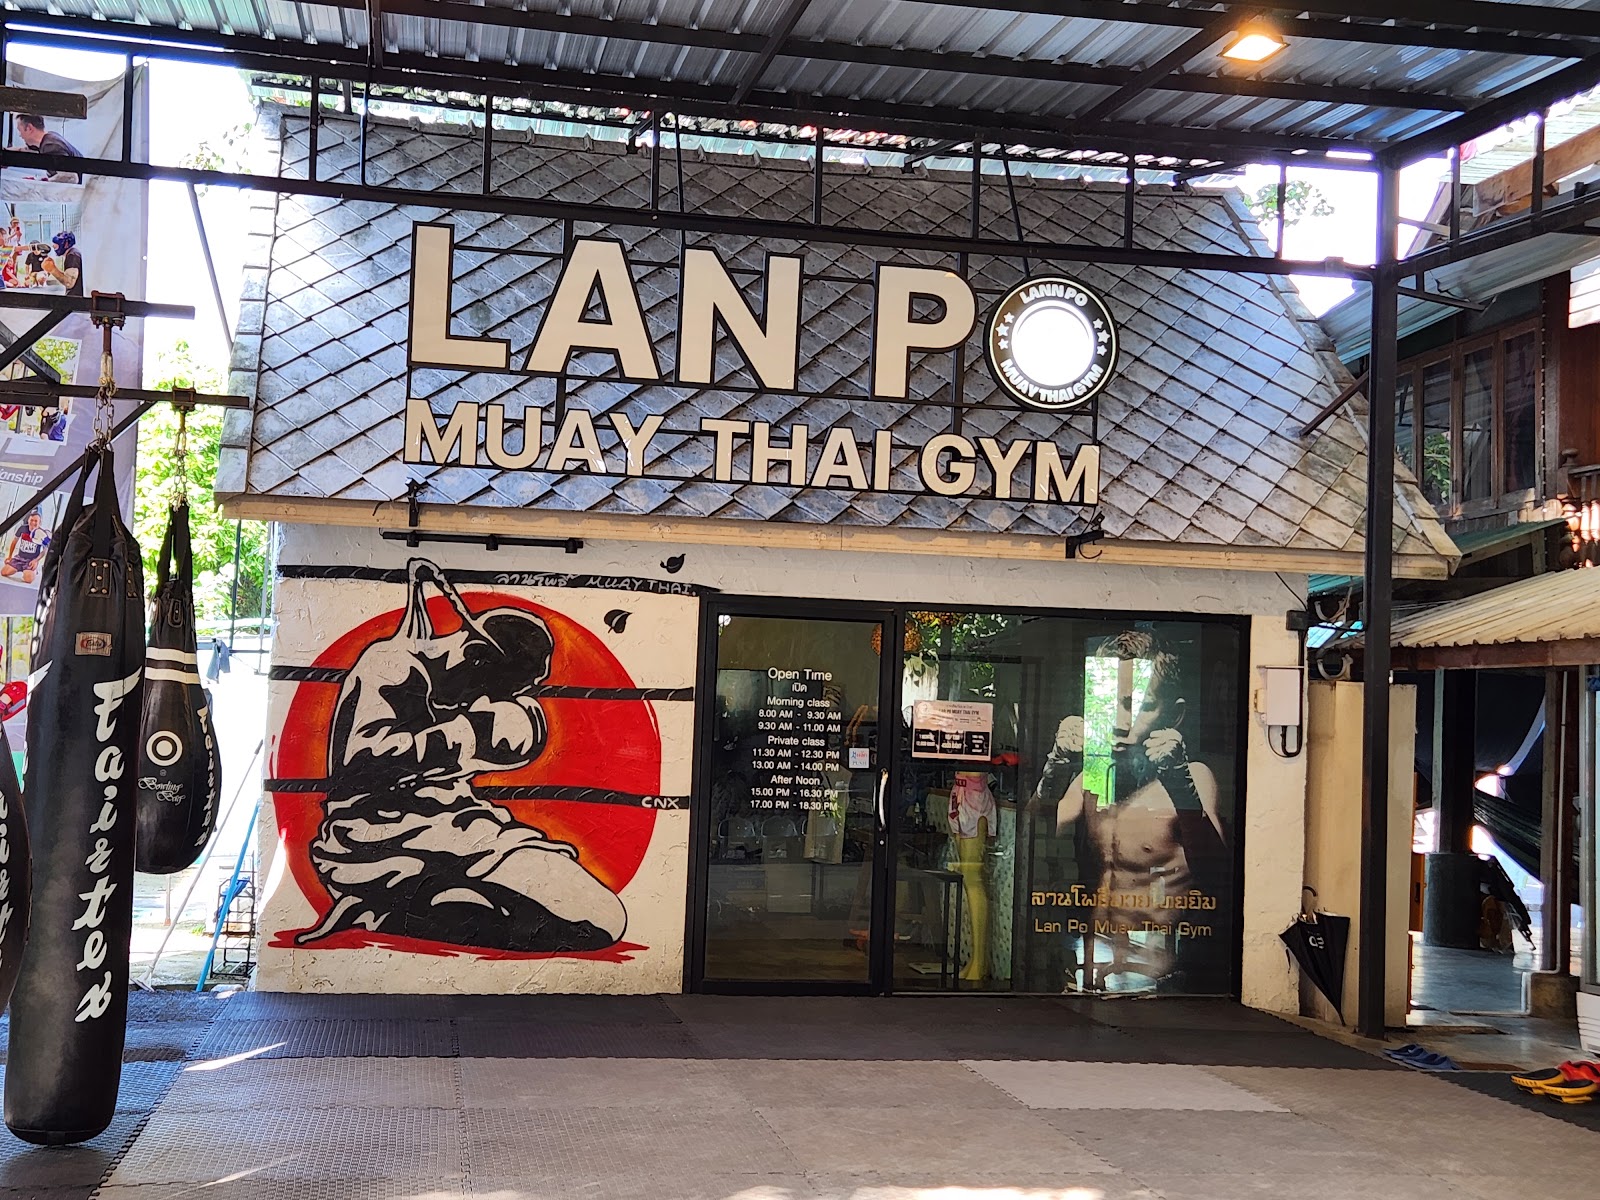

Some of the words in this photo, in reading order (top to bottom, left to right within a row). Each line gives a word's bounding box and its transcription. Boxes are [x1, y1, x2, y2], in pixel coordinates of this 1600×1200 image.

[408, 220, 804, 394] LAN
[403, 397, 665, 478] MUAY
[700, 415, 894, 492] THAI
[919, 432, 1100, 506] GYM
[586, 576, 643, 590] MUAY
[768, 667, 800, 682] Open
[804, 668, 832, 681] Time
[766, 696, 804, 708] Morning
[806, 697, 830, 708] class
[758, 709, 776, 718] 8.00
[778, 710, 793, 718] AM
[806, 711, 824, 720] 9.30
[827, 712, 841, 720] AM
[758, 722, 776, 730] 9.30
[778, 722, 792, 730] AM
[803, 724, 824, 732] 11.00
[826, 724, 840, 732] AM
[768, 735, 799, 745] Private
[802, 737, 825, 746] class
[753, 748, 774, 757] 11.30
[777, 749, 791, 757] AM
[801, 750, 823, 758] 12.30
[826, 750, 840, 759] PM
[752, 761, 774, 769] 13.00
[776, 761, 791, 770] AM
[800, 762, 822, 771] 14.00
[825, 763, 839, 771] PM
[138, 777, 184, 794] Bowling
[770, 774, 793, 784] After
[796, 776, 820, 785] Noon
[751, 788, 773, 796] 15.00
[776, 788, 789, 797] PM
[799, 789, 822, 798] 16.30
[824, 790, 838, 798] PM
[642, 796, 680, 810] CNX
[750, 800, 772, 808] 17.00
[775, 801, 789, 809] PM
[799, 802, 821, 810] 18.30
[823, 802, 838, 810] PM
[72, 665, 142, 1022] Fairtex
[1034, 918, 1061, 933] Lan
[1068, 919, 1088, 934] Po
[1178, 921, 1212, 939] Gym
